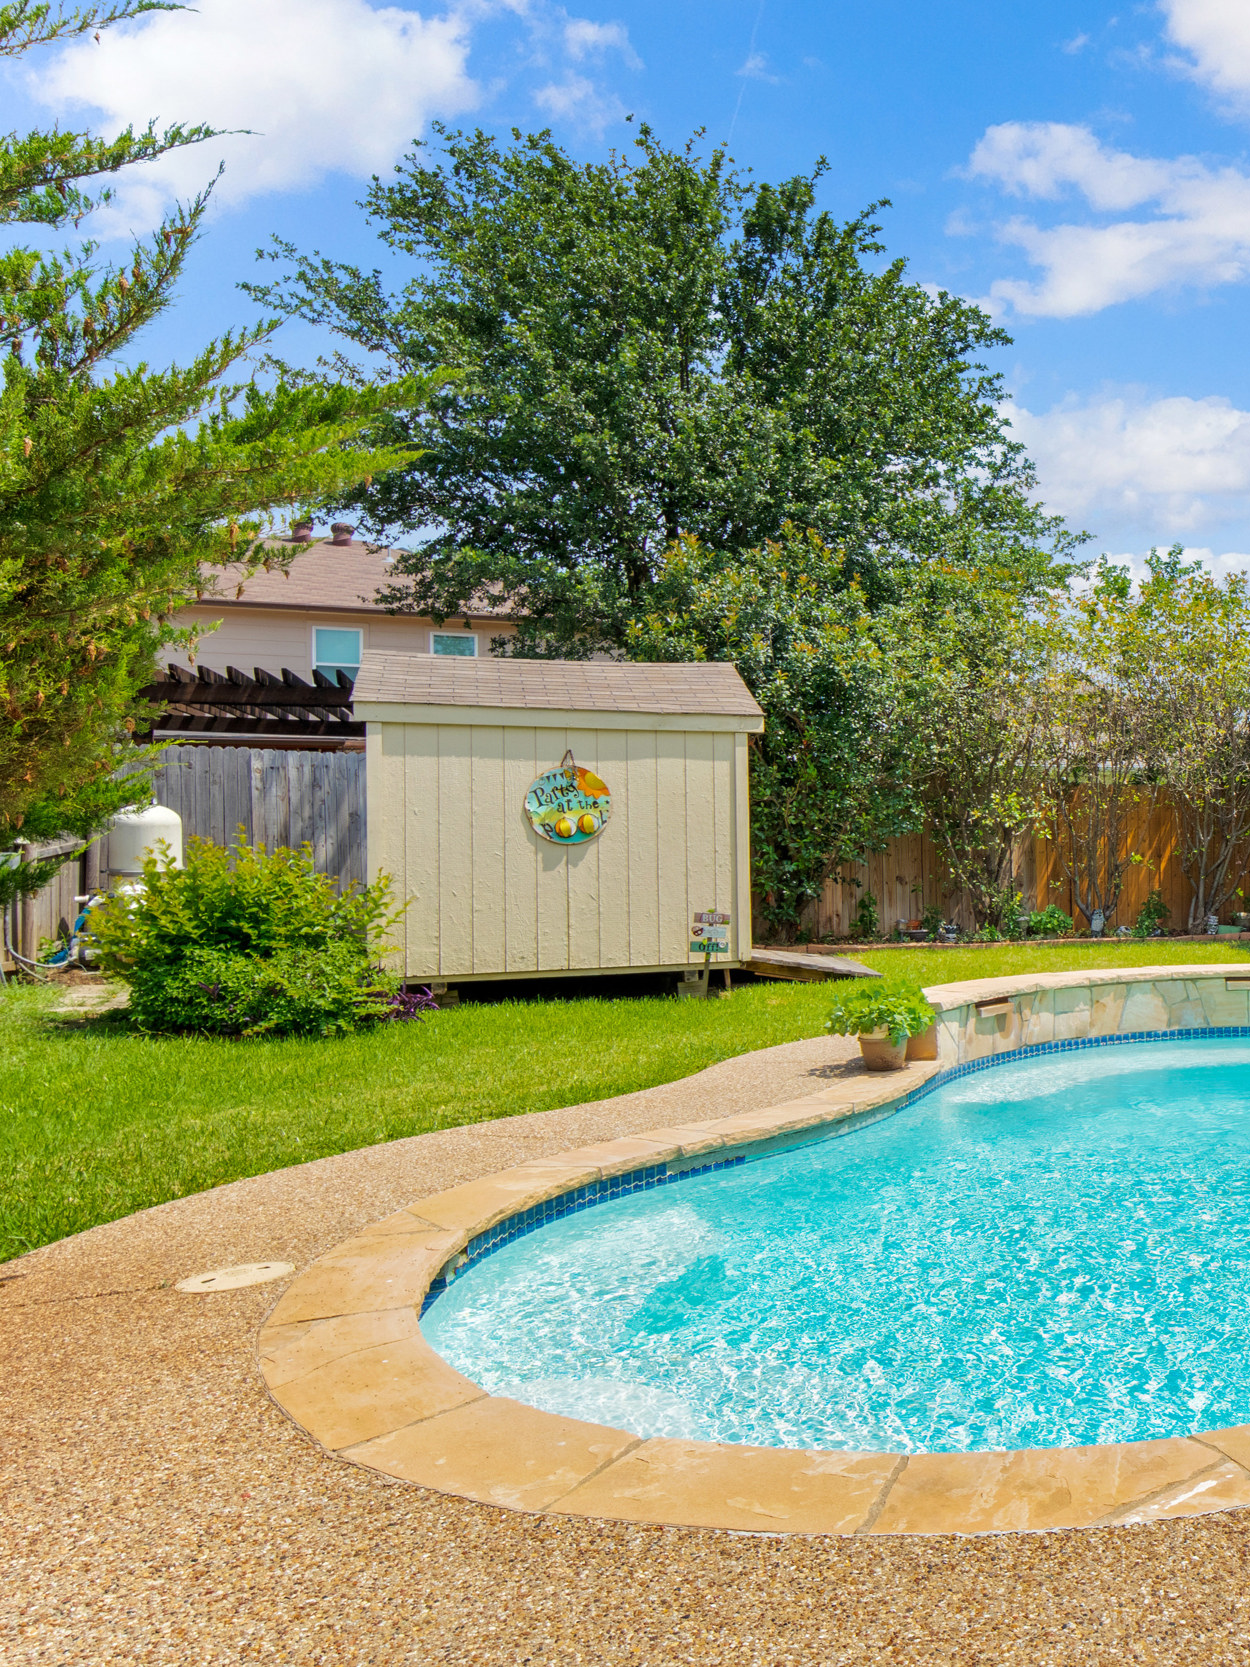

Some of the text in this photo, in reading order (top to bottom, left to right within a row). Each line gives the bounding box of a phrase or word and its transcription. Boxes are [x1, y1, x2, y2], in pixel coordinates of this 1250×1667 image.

[529, 783, 580, 808] Party
[557, 799, 600, 814] at the
[702, 914, 723, 923] BUG
